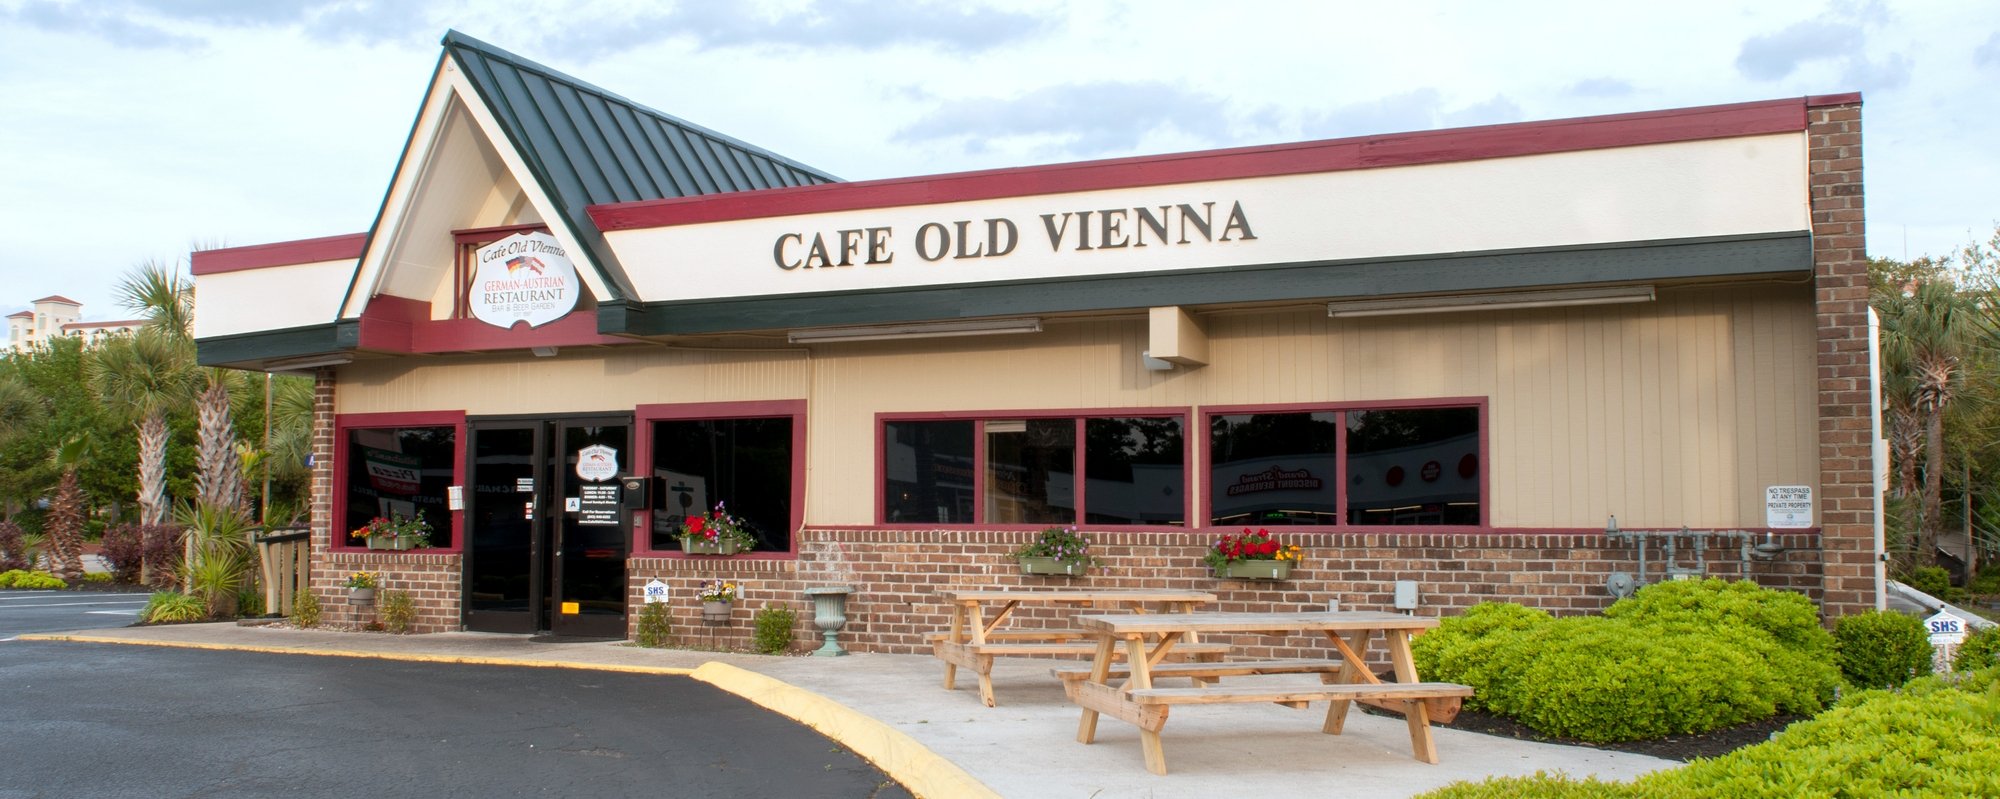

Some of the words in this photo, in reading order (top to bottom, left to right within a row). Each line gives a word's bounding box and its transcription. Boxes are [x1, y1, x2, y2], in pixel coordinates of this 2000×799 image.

[773, 226, 893, 271] CAFE
[915, 218, 1019, 262] OLD
[1039, 200, 1258, 252] VIENNA
[483, 245, 507, 263] Cafe
[508, 240, 529, 255] Old
[529, 240, 566, 258] Vienna
[484, 276, 565, 292] GERMAN-AUSTRIAN
[484, 288, 565, 304] RESTAURANT
[647, 586, 664, 595] SHS
[1931, 620, 1958, 632] SHS
